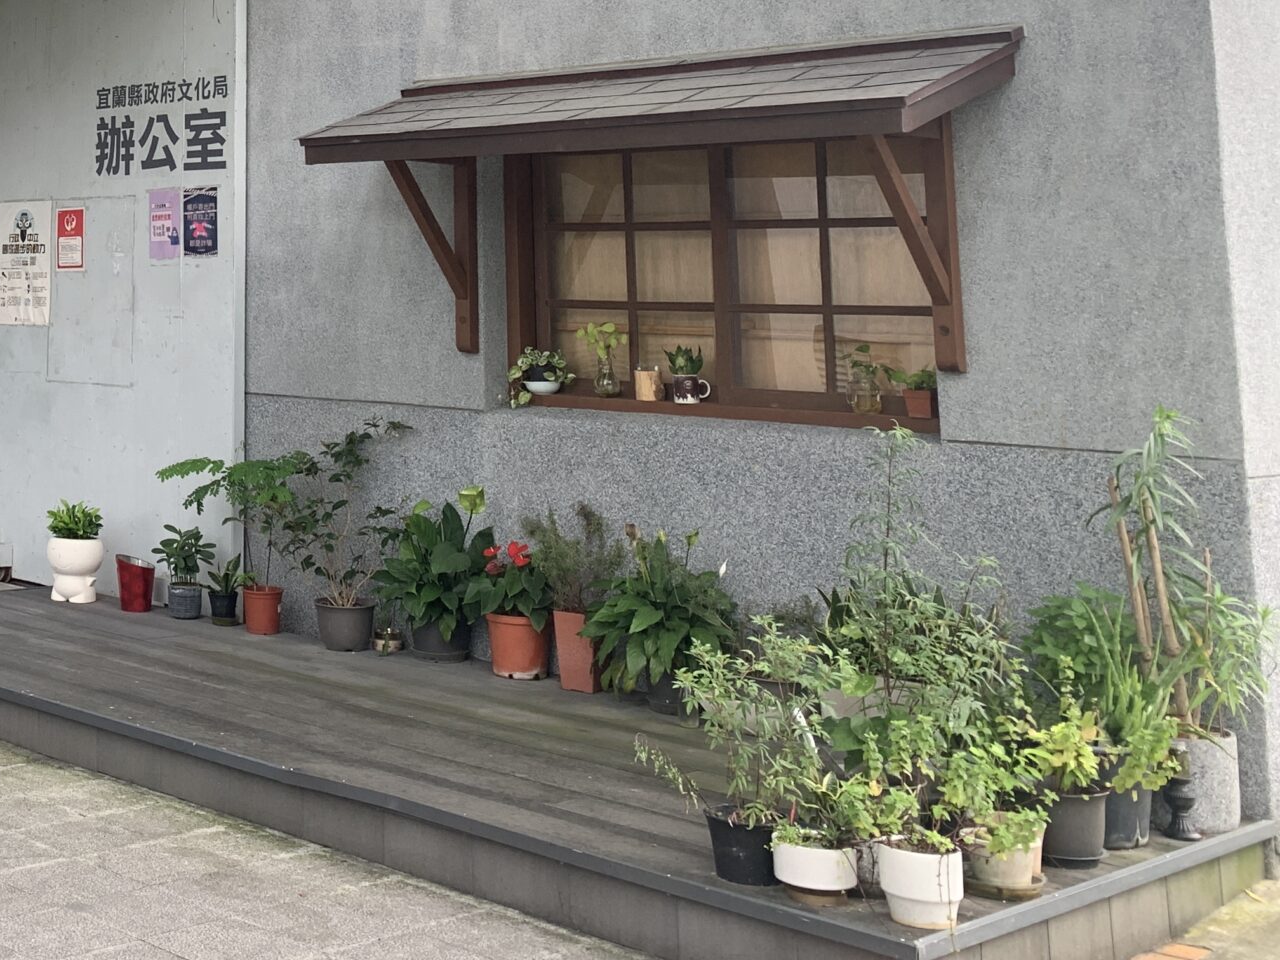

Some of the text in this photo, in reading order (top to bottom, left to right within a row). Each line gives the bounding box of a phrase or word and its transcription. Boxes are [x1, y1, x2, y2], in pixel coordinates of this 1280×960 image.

[96, 75, 228, 109] 宜蘭縣政府文化局
[96, 108, 227, 176] 辦公室
